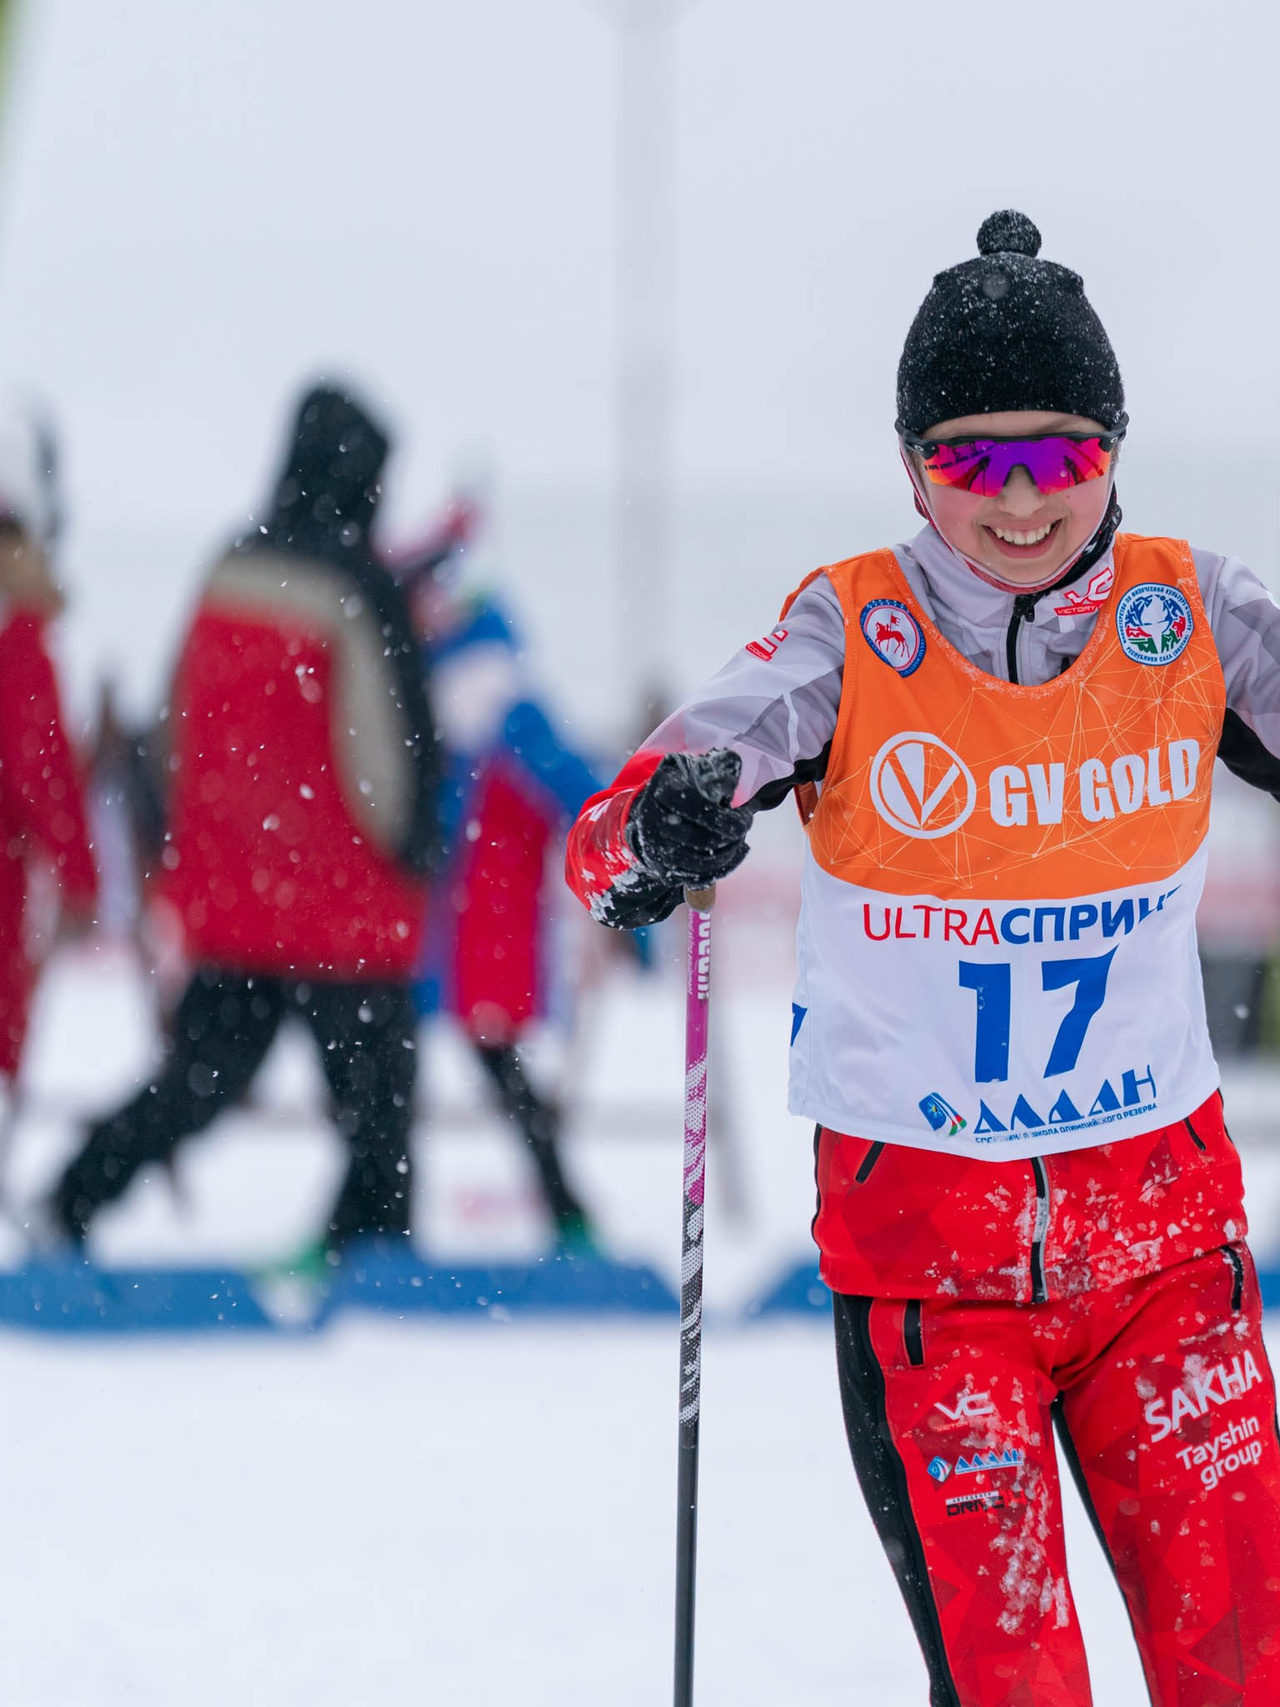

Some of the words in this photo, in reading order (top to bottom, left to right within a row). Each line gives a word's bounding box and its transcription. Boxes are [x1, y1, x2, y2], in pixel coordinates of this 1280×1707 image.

[1056, 604, 1097, 615] VICTORY
[989, 762, 1065, 827] GV
[1079, 738, 1201, 823] GOLD
[959, 944, 1120, 1084] 17
[1123, 1102, 1158, 1119] РЕЗЕРВА
[1144, 1350, 1263, 1444] SAKHA
[1176, 1416, 1260, 1471] Tayshin
[1200, 1441, 1262, 1491] group
